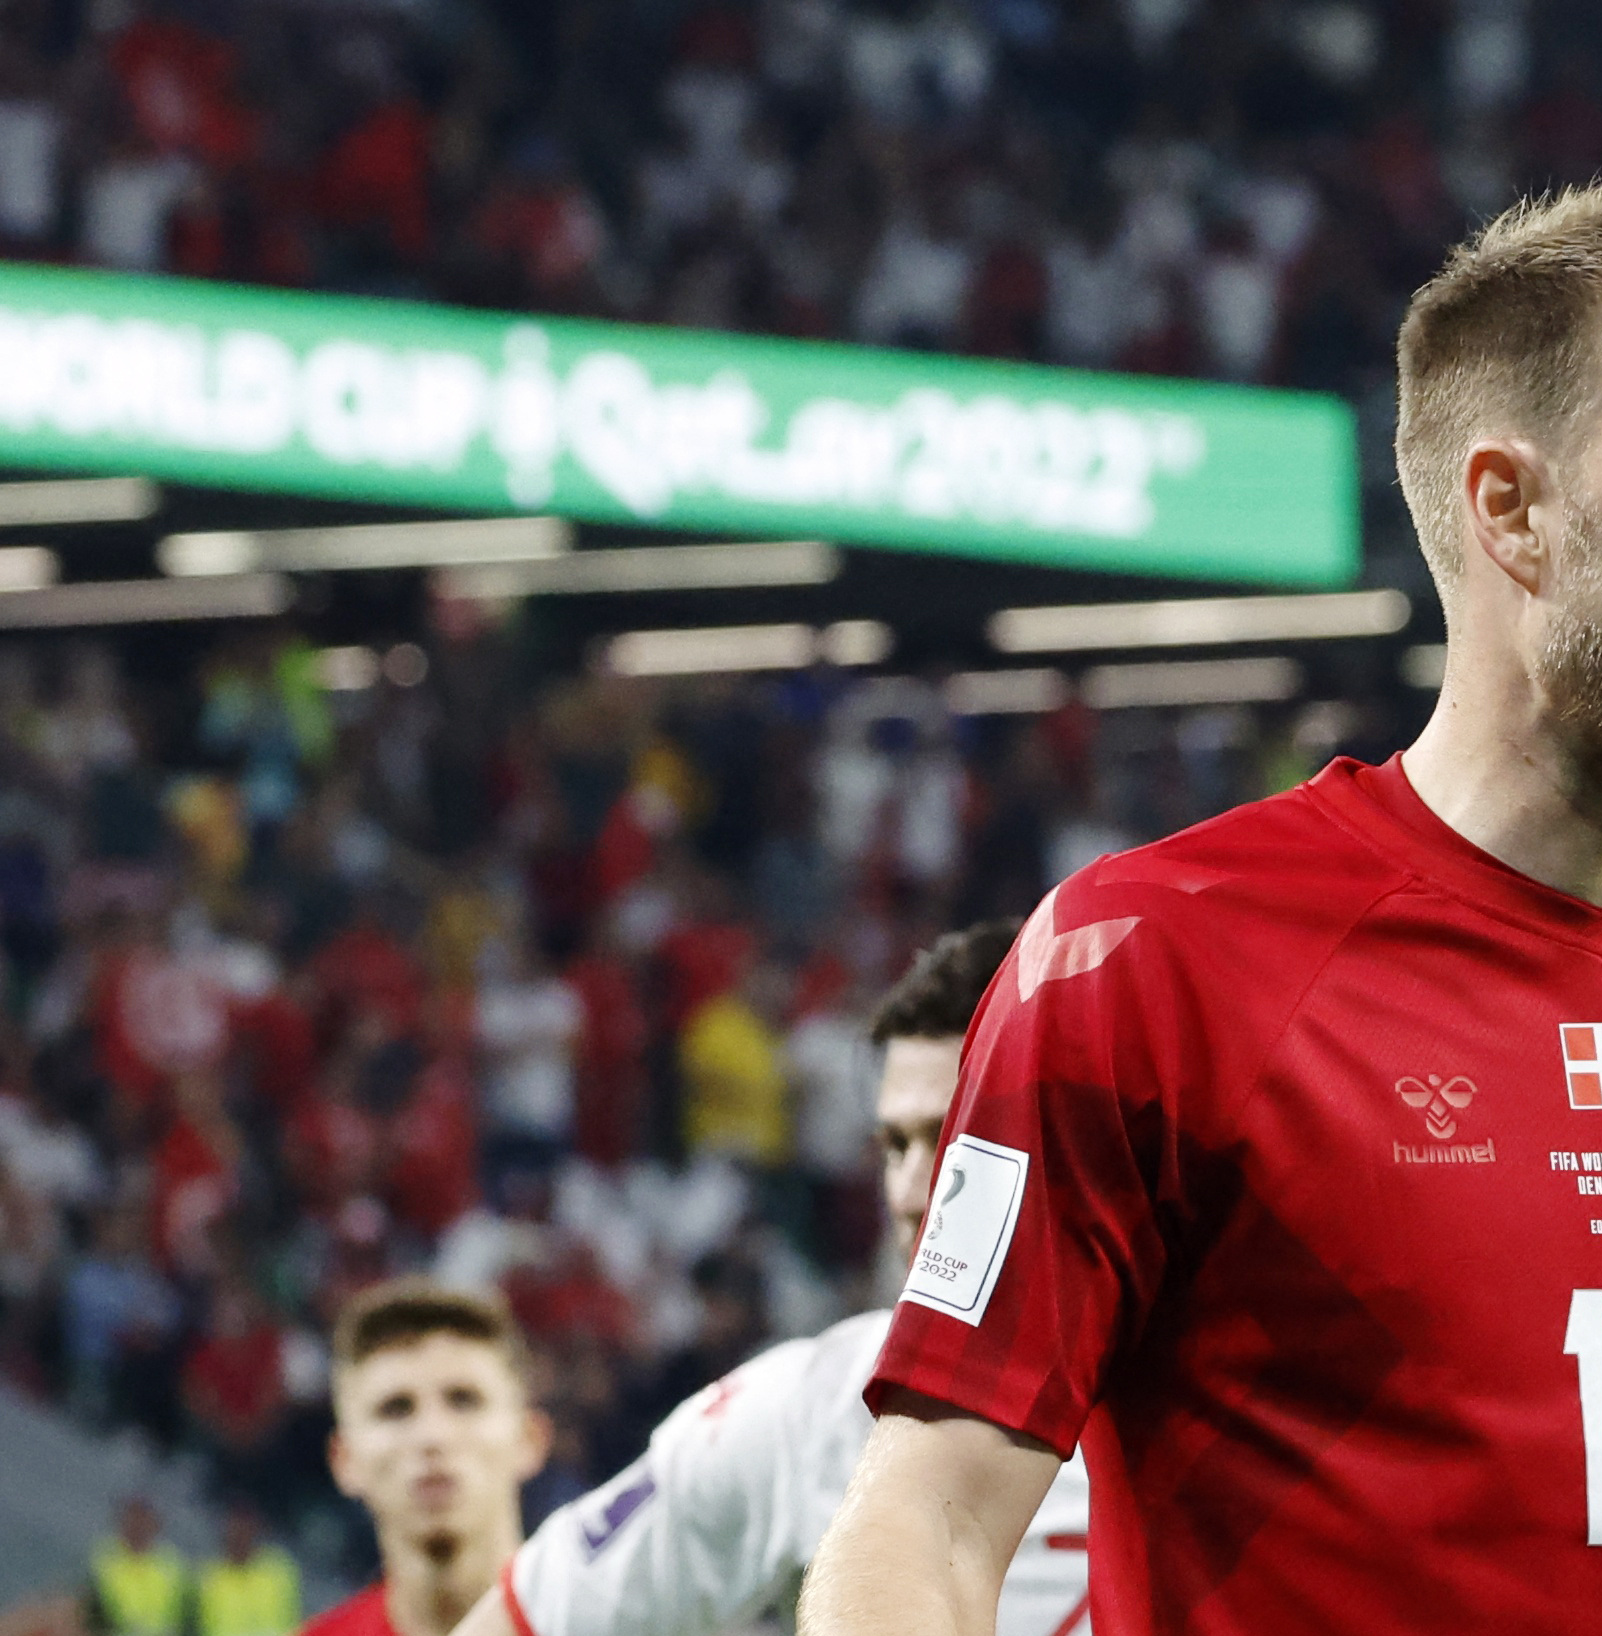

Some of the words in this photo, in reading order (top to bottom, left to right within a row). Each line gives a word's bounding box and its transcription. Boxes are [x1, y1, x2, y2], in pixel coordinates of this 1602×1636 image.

[1393, 1138, 1496, 1163] hummel
[1550, 1152, 1579, 1171] FIFA
[921, 1248, 943, 1262] RLD
[944, 1256, 968, 1271] CUP
[920, 1260, 957, 1282] 2022
